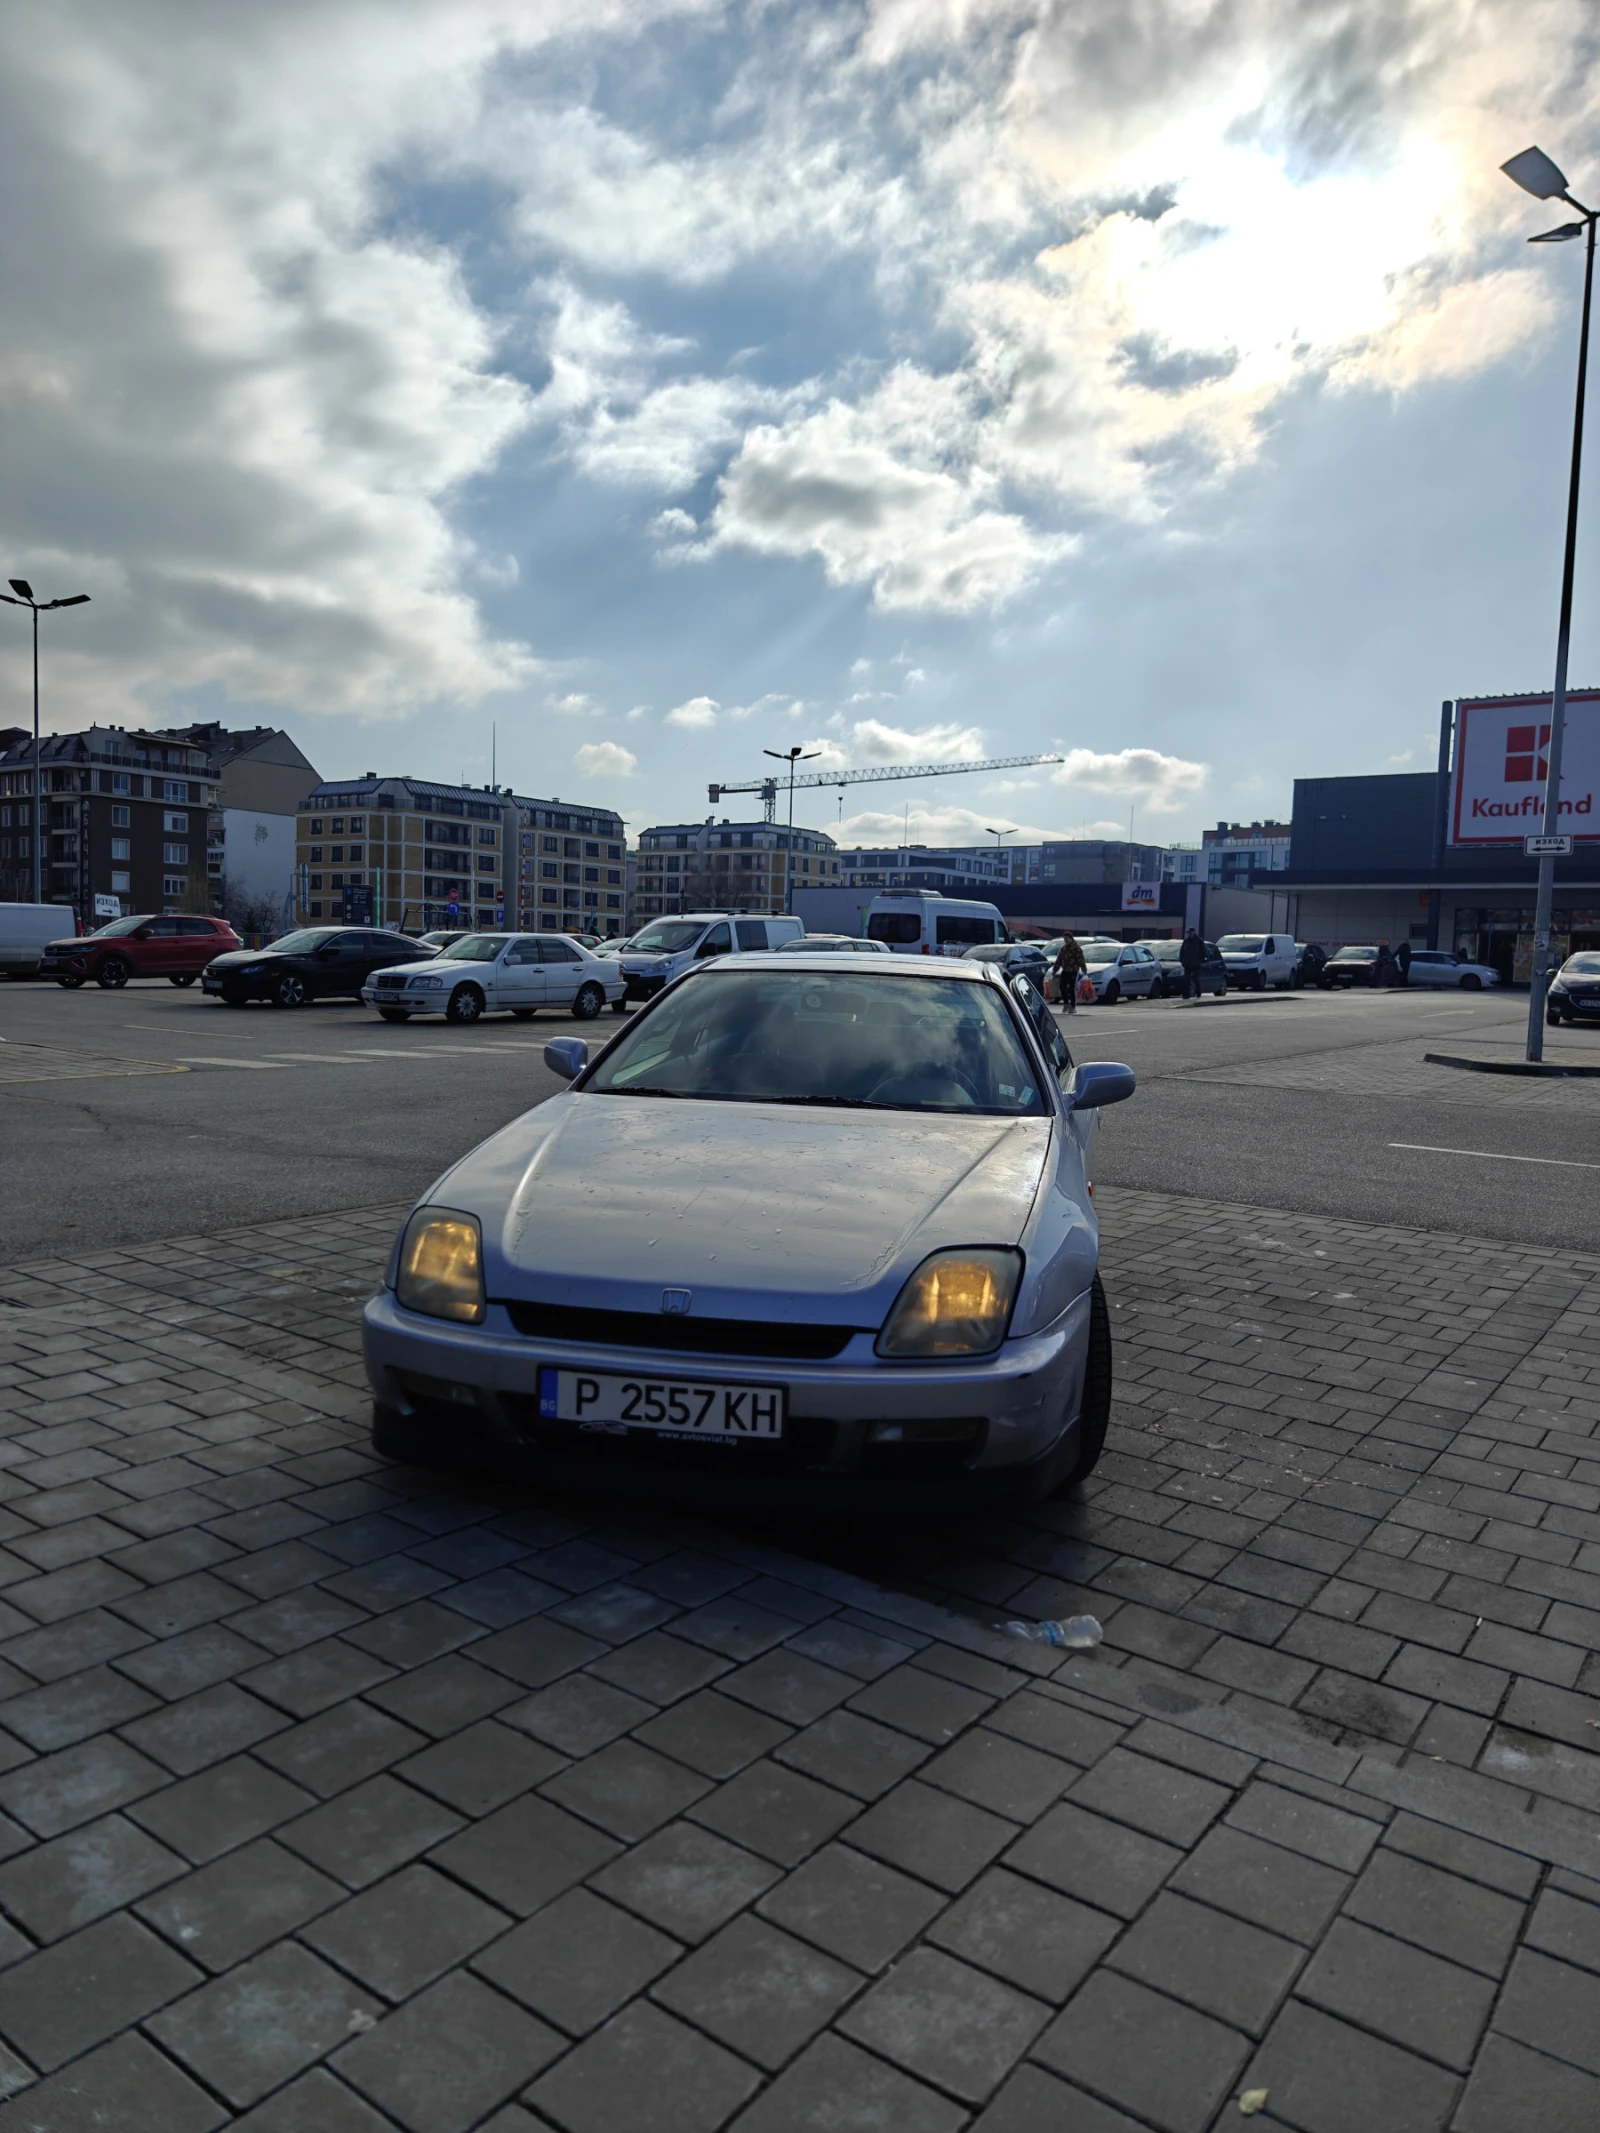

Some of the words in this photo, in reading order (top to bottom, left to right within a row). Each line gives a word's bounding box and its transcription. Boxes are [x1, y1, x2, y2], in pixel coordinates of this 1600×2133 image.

[1535, 838, 1565, 846] ИЗХОД
[1131, 886, 1153, 899] dm
[96, 897, 119, 908] ИЗХОД
[540, 1399, 556, 1412] BG
[576, 1378, 600, 1416] P
[620, 1382, 715, 1428] 2557
[724, 1391, 777, 1433] KH
[657, 1431, 737, 1446] www.avtosviat.bg
